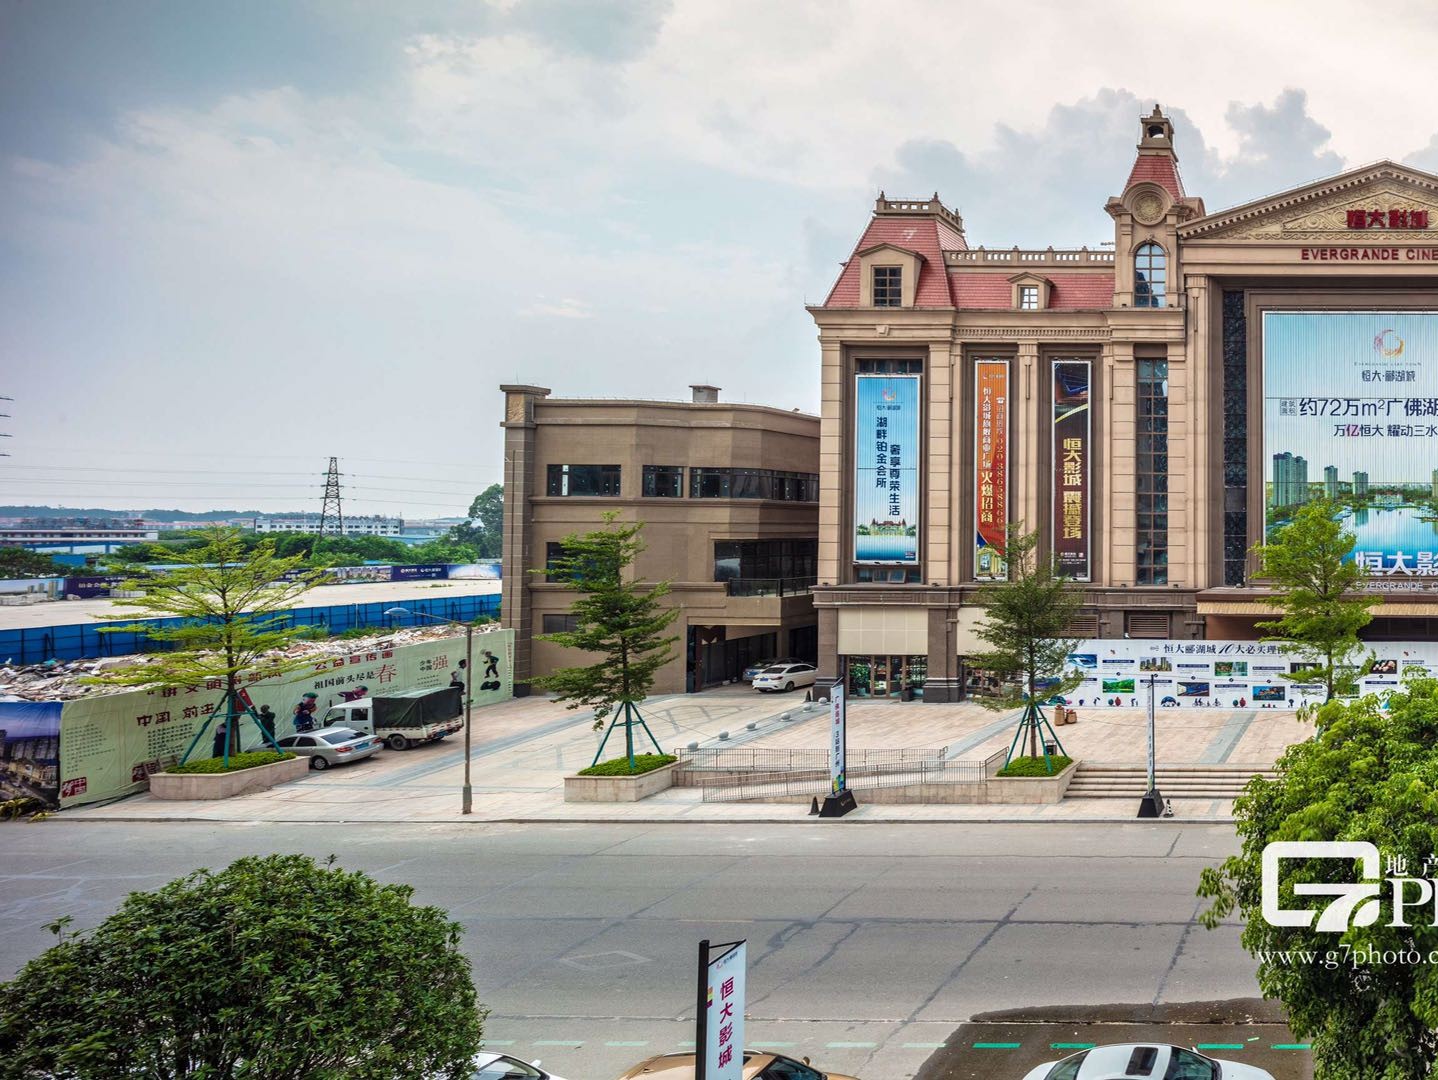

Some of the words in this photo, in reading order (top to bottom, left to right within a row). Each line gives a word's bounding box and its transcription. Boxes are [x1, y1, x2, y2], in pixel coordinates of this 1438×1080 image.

[1346, 208, 1428, 230] 恒大影城
[1301, 248, 1399, 261] EVERGRANDE
[1333, 424, 1384, 437] 万亿恒大
[1387, 424, 1438, 437] 耀动三水
[876, 416, 888, 488] 湖畔铂金会所
[1063, 438, 1082, 486] 恒大影城
[889, 444, 901, 516] 奢享尊荣生活
[1356, 581, 1423, 590] EVERGRANDE
[718, 976, 735, 1069] 恒大影城
